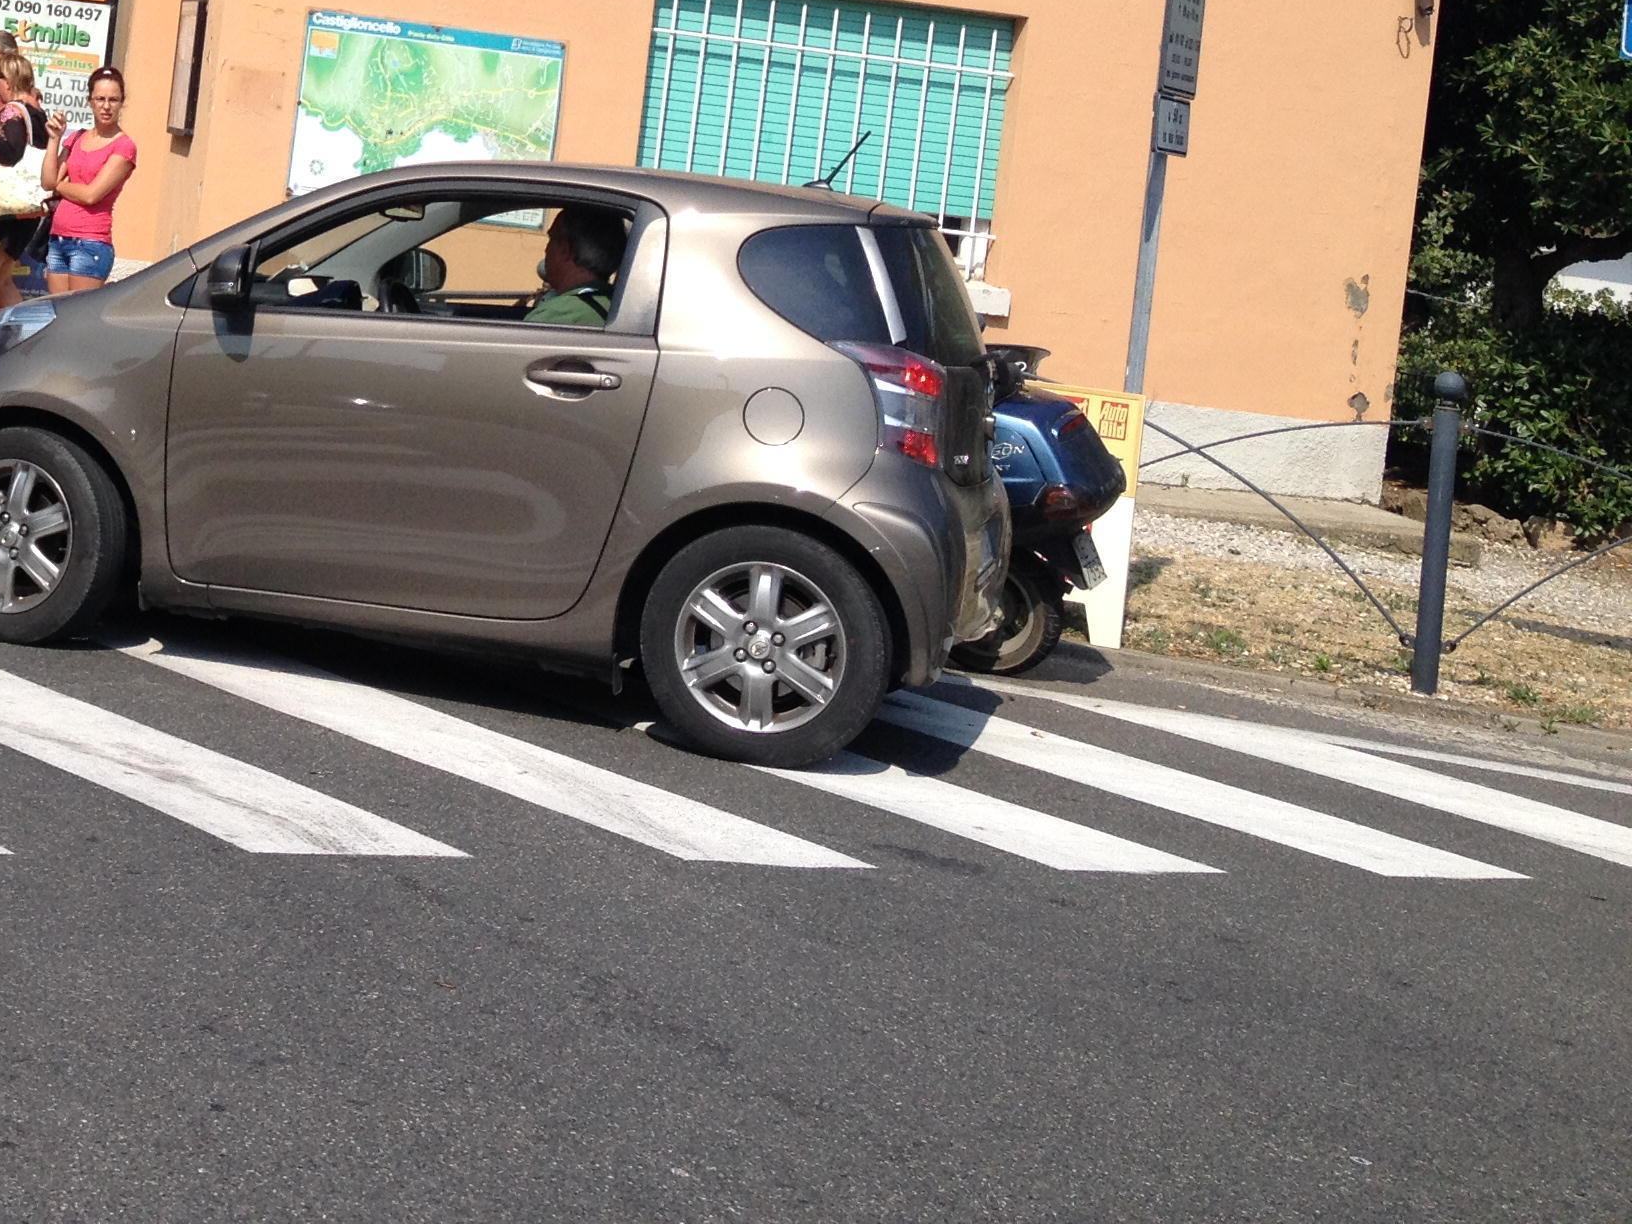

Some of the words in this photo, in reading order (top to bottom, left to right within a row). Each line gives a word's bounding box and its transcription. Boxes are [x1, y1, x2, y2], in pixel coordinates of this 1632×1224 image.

[14, 0, 42, 15] 090
[46, 3, 72, 18] 160
[74, 7, 103, 22] 497
[312, 11, 402, 35] Castiglioncello
[45, 76, 63, 90] LA
[70, 79, 89, 92] TU
[44, 108, 93, 125] AONE
